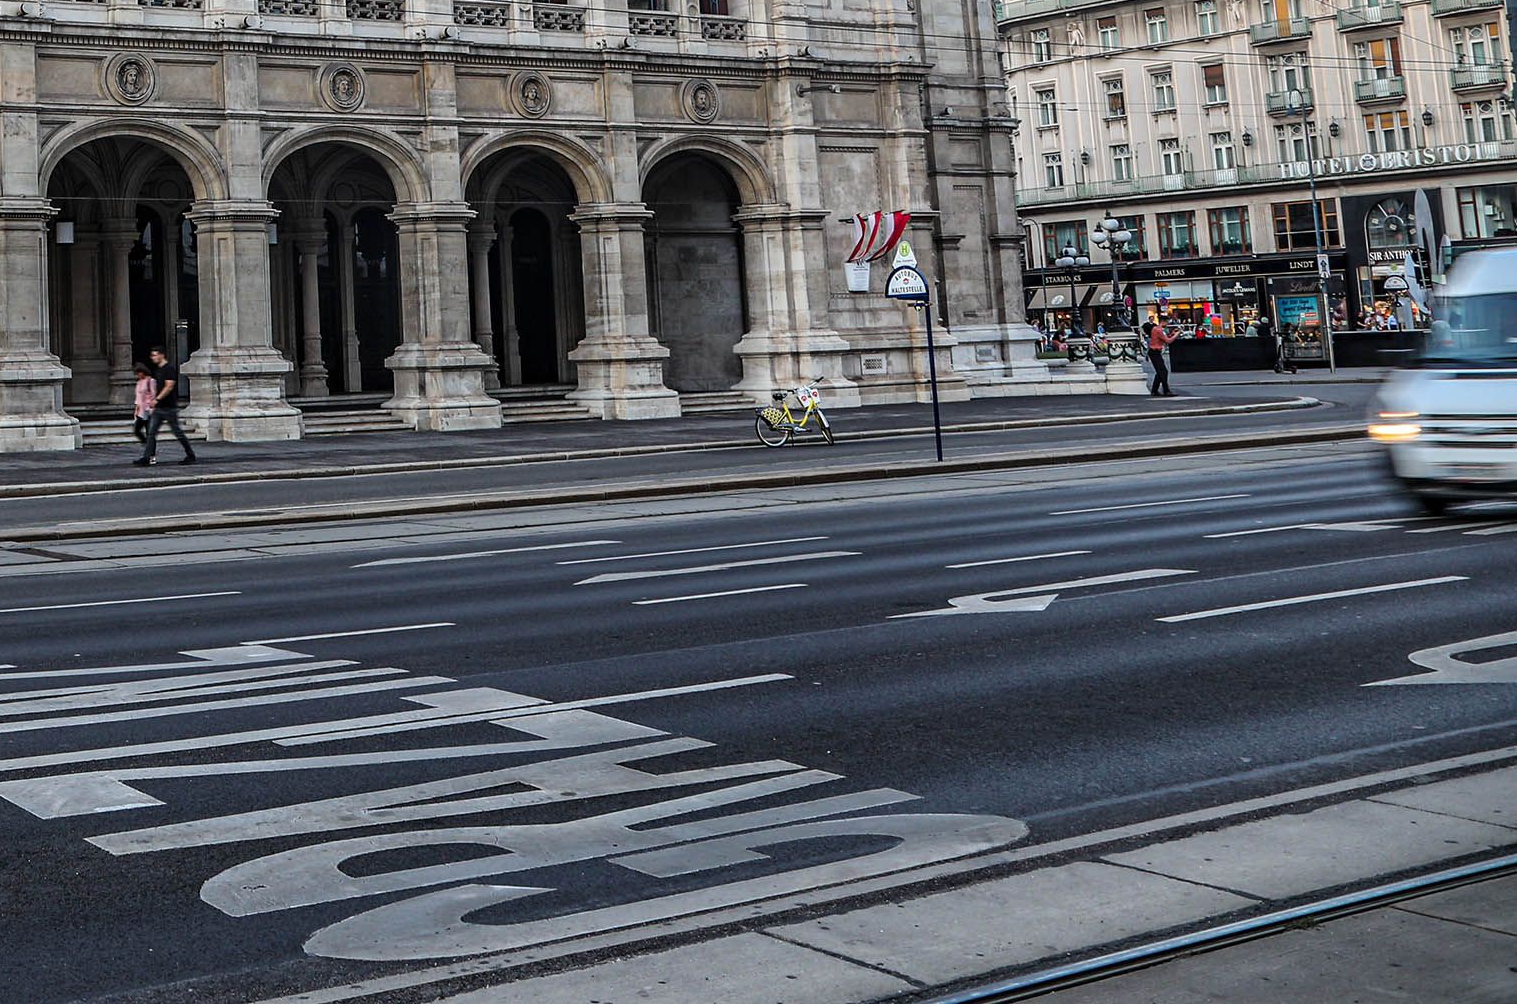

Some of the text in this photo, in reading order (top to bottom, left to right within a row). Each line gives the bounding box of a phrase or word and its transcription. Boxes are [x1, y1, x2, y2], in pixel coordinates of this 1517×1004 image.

[1280, 143, 1490, 179] HOTEL BRISTOL
[1369, 251, 1383, 261] SIR
[1215, 264, 1251, 275] JUWELIER
[1289, 260, 1314, 269] LINDT
[894, 270, 918, 282] AUTOBUS
[1154, 268, 1186, 277] PALMERS
[891, 285, 923, 293] HALTESTELLE
